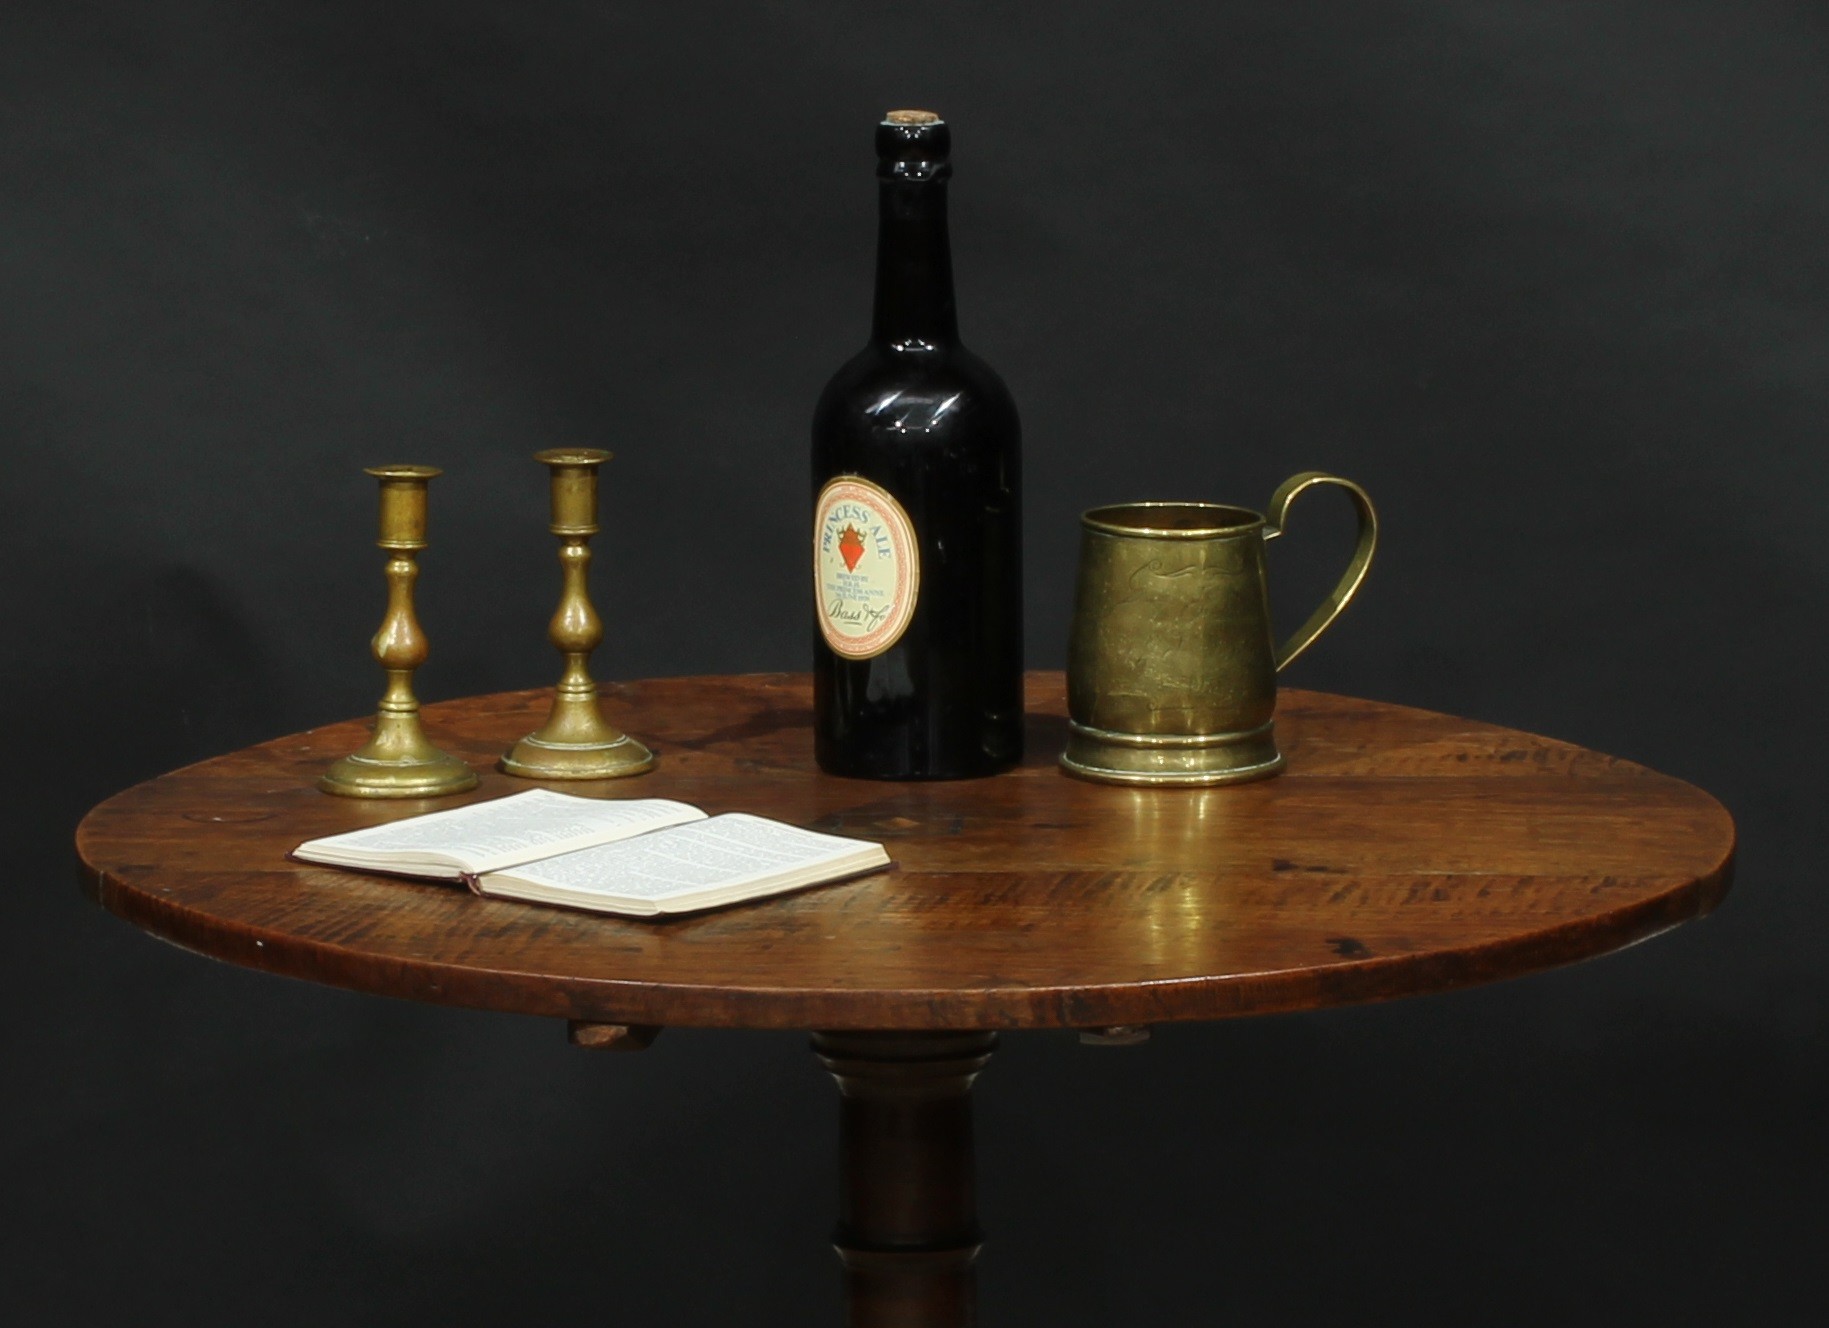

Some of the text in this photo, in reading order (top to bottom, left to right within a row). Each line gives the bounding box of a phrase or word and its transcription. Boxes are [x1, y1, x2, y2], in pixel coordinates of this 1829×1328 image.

[823, 505, 891, 559] PRINCESS ALE
[829, 599, 862, 620] Bass
